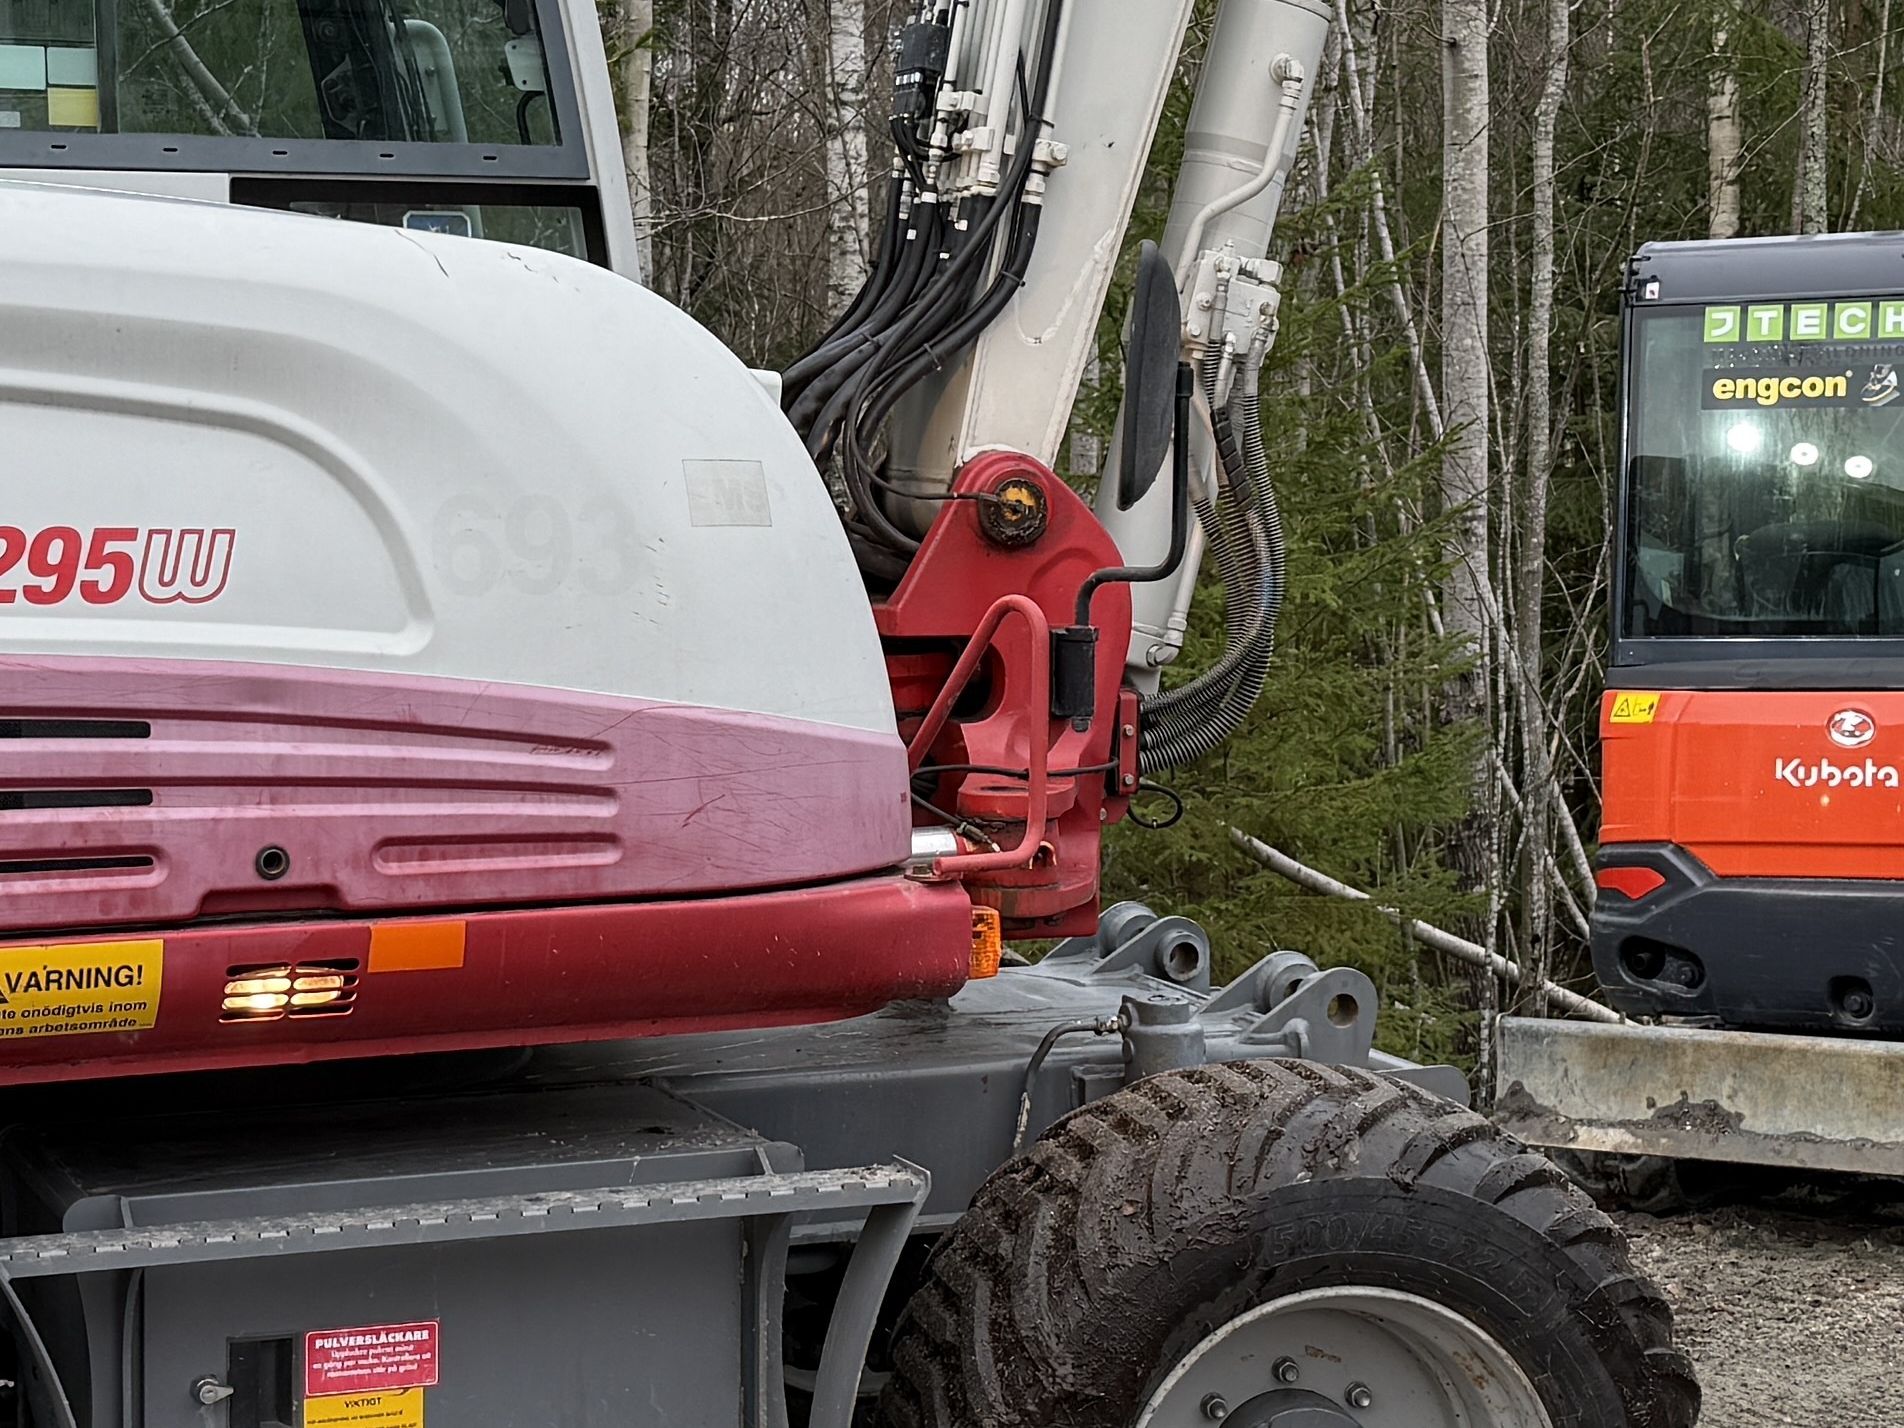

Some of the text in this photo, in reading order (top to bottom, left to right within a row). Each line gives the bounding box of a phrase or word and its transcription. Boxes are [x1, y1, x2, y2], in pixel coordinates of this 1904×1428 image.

[1712, 375, 1846, 405] engcon
[1776, 757, 1899, 787] Kubota
[4, 964, 144, 994] VARNING!
[108, 1000, 148, 1013] inom
